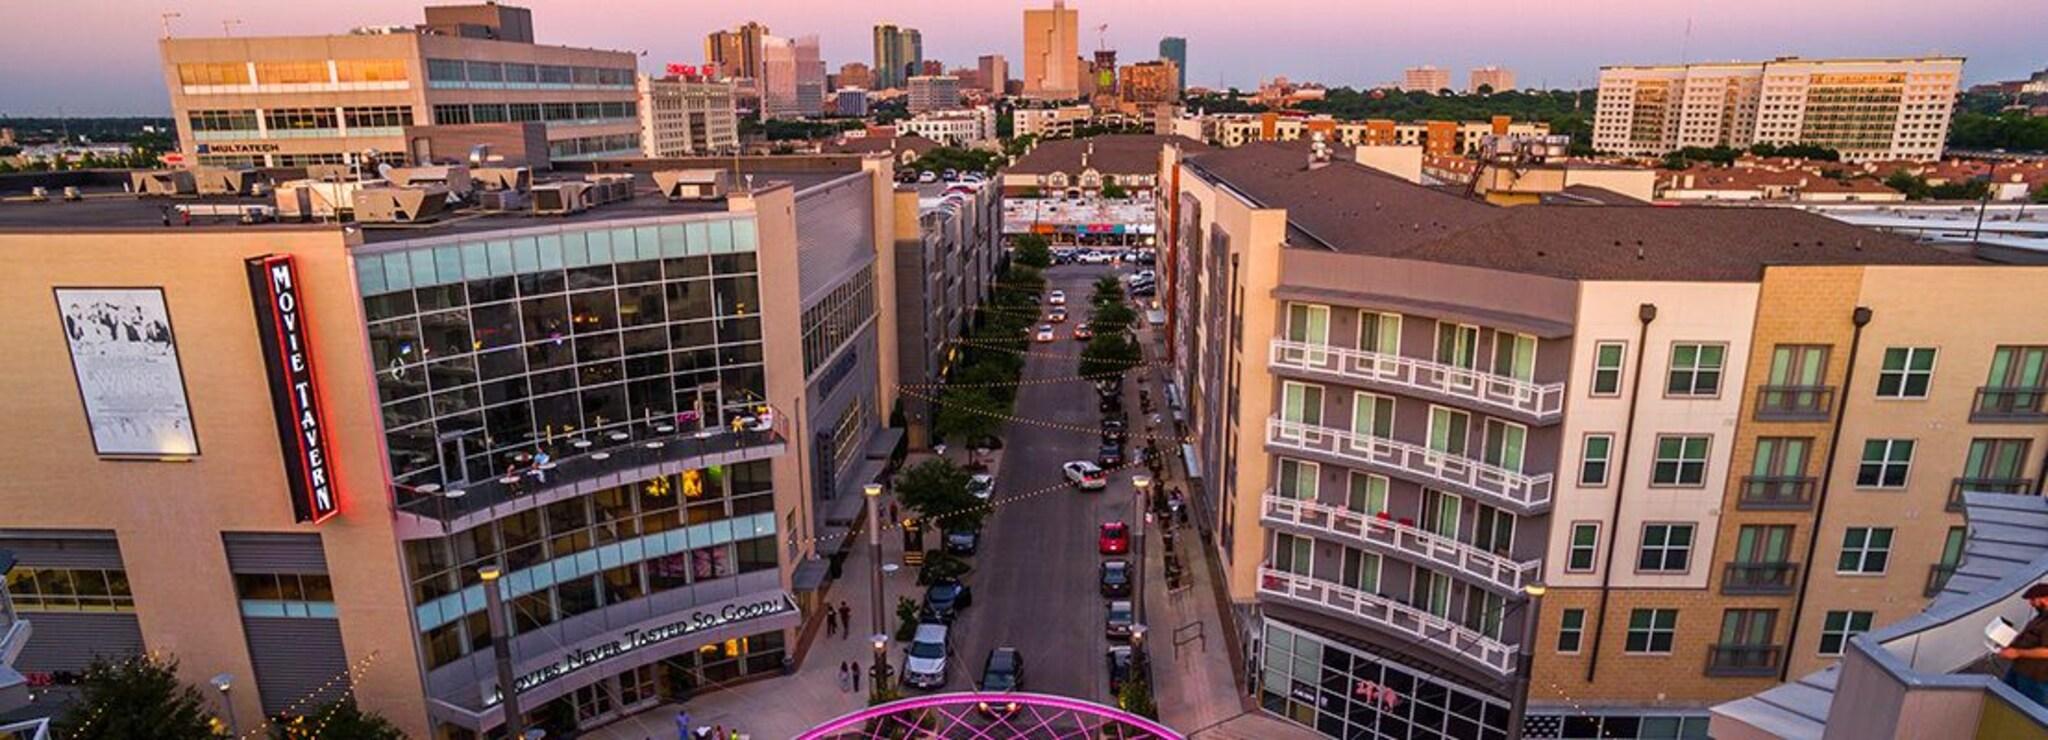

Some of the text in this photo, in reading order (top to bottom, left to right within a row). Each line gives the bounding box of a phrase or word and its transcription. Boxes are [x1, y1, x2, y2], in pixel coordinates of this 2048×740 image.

[210, 143, 279, 153] MULTATECH
[271, 264, 331, 511] MOVIE TAVERN
[566, 638, 621, 668] NEVER
[624, 620, 687, 648] TASTED
[692, 611, 716, 630] SO
[721, 599, 780, 622] GOOD!
